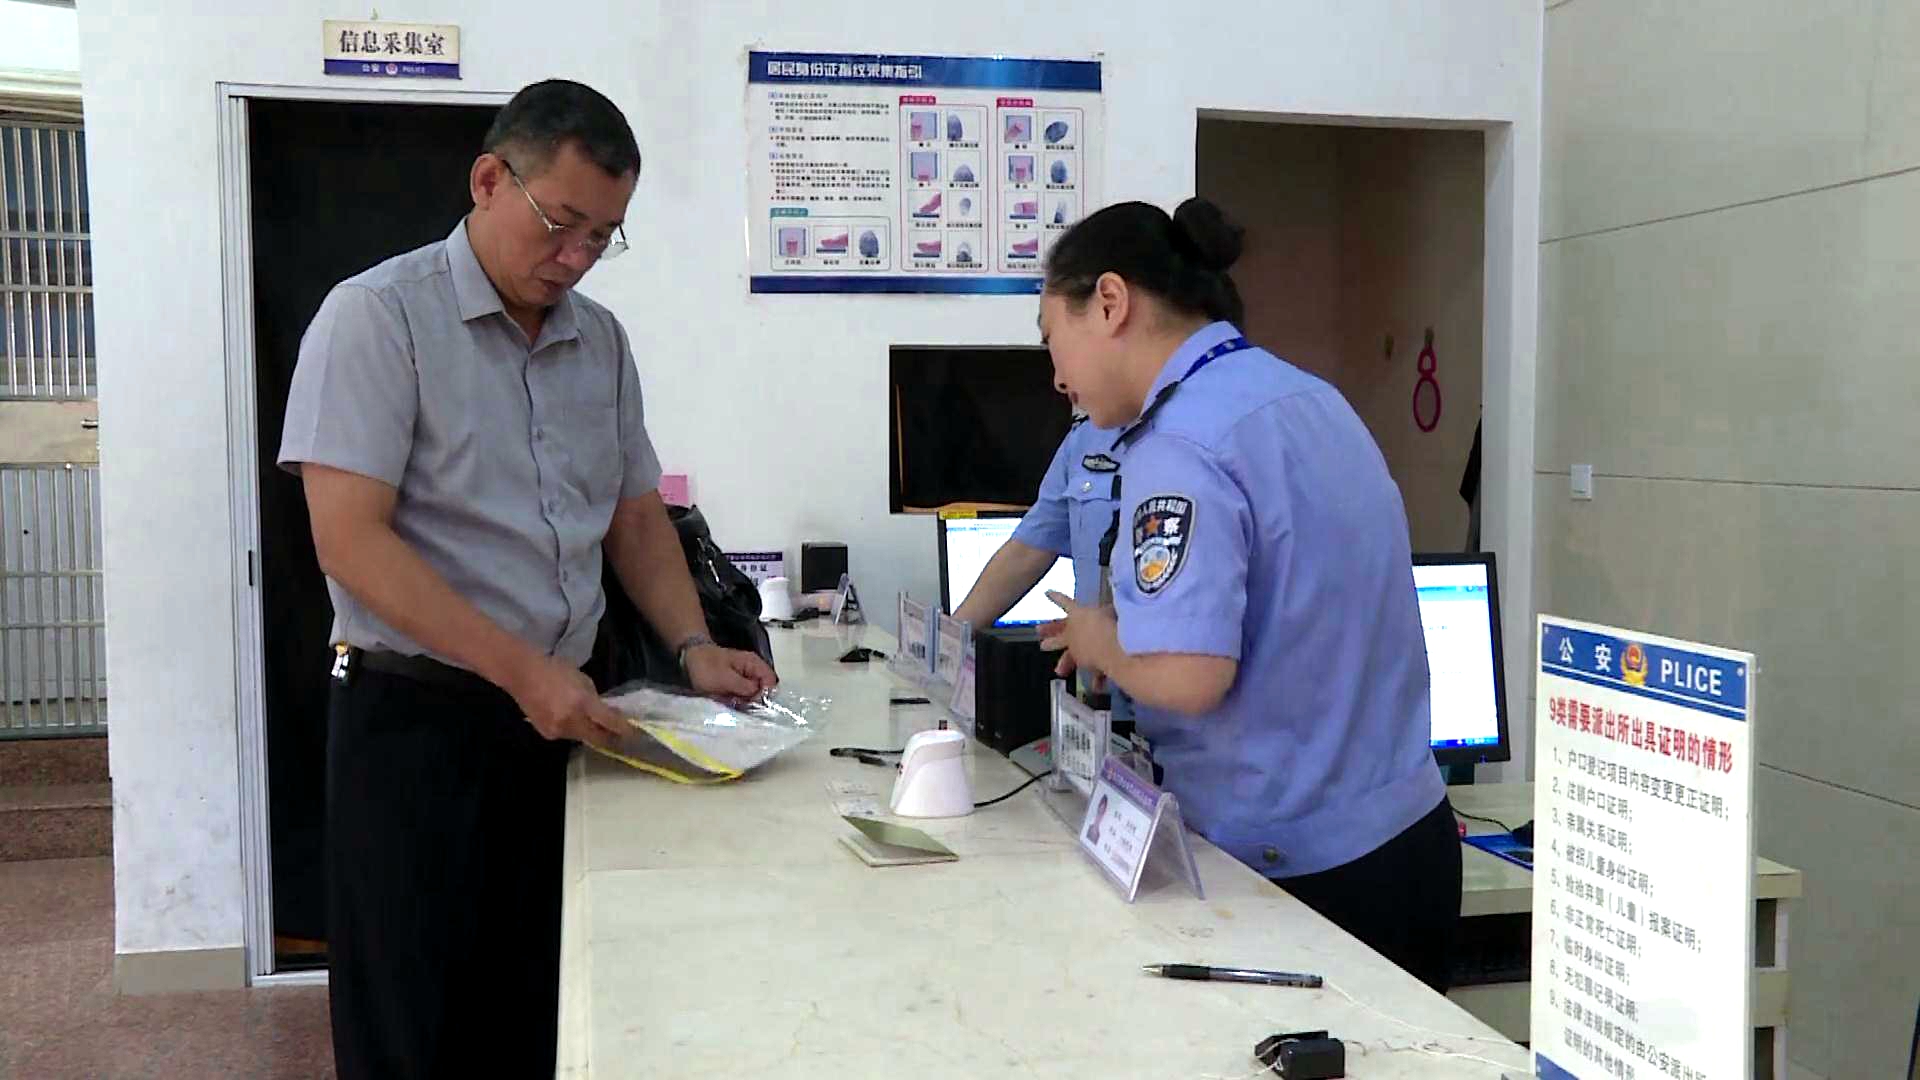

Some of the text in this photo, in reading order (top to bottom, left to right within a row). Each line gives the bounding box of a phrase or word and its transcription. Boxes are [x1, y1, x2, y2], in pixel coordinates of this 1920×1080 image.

[340, 30, 444, 55] 信息采集室
[767, 60, 922, 79] 居民身份证指纹采集指引
[1661, 658, 1722, 697] PLICE
[1549, 698, 1733, 774] 9类需要派出所出具证明的情形
